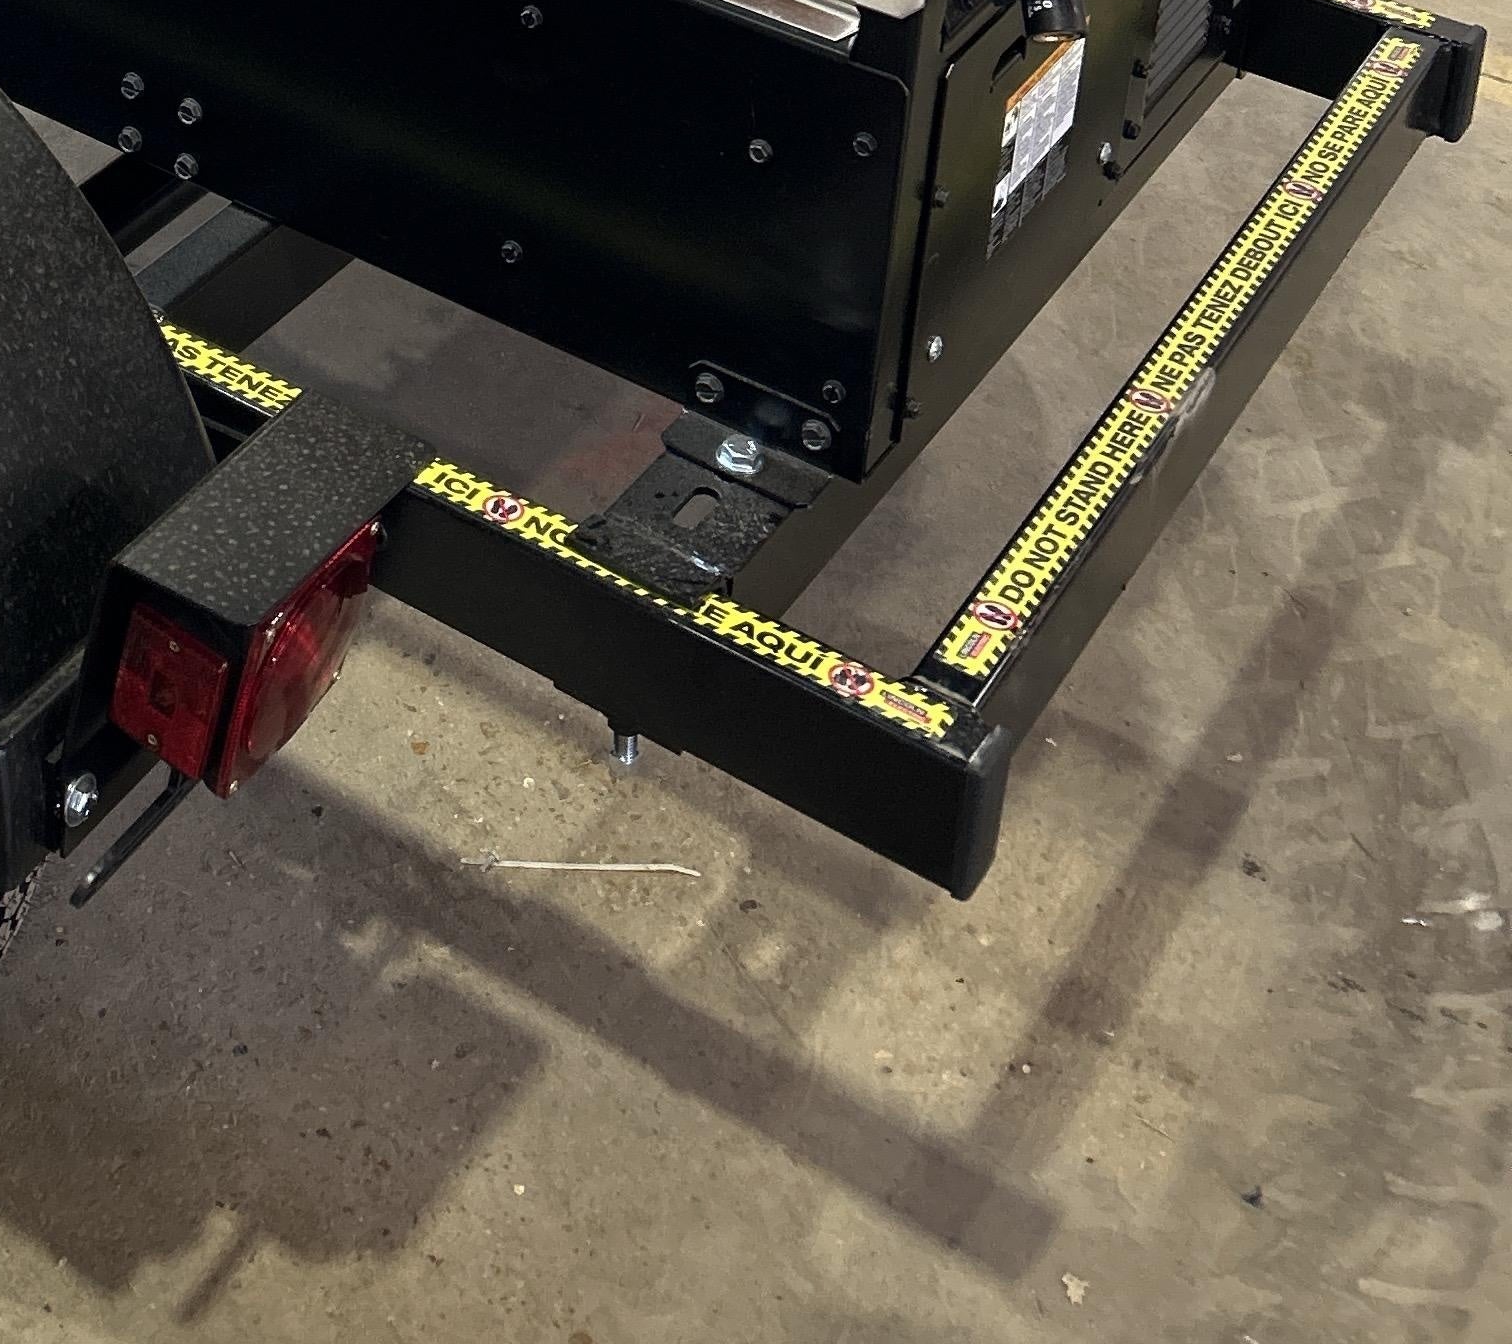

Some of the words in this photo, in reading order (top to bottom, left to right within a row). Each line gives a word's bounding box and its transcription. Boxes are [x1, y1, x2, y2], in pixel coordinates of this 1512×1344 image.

[1301, 160, 1331, 185] NO
[1318, 140, 1345, 162] SE
[1337, 105, 1370, 143] PARE
[1151, 366, 1184, 393] NE
[1168, 330, 1207, 369] PAS
[1192, 279, 1243, 332] TENEZ
[1230, 219, 1288, 282] DEBOUT
[1277, 198, 1304, 223] ICI
[433, 470, 479, 500] ICI
[998, 568, 1037, 605] DO
[1027, 523, 1066, 566] NOT
[1054, 459, 1115, 528] STAND
[1101, 410, 1152, 463] HERE
